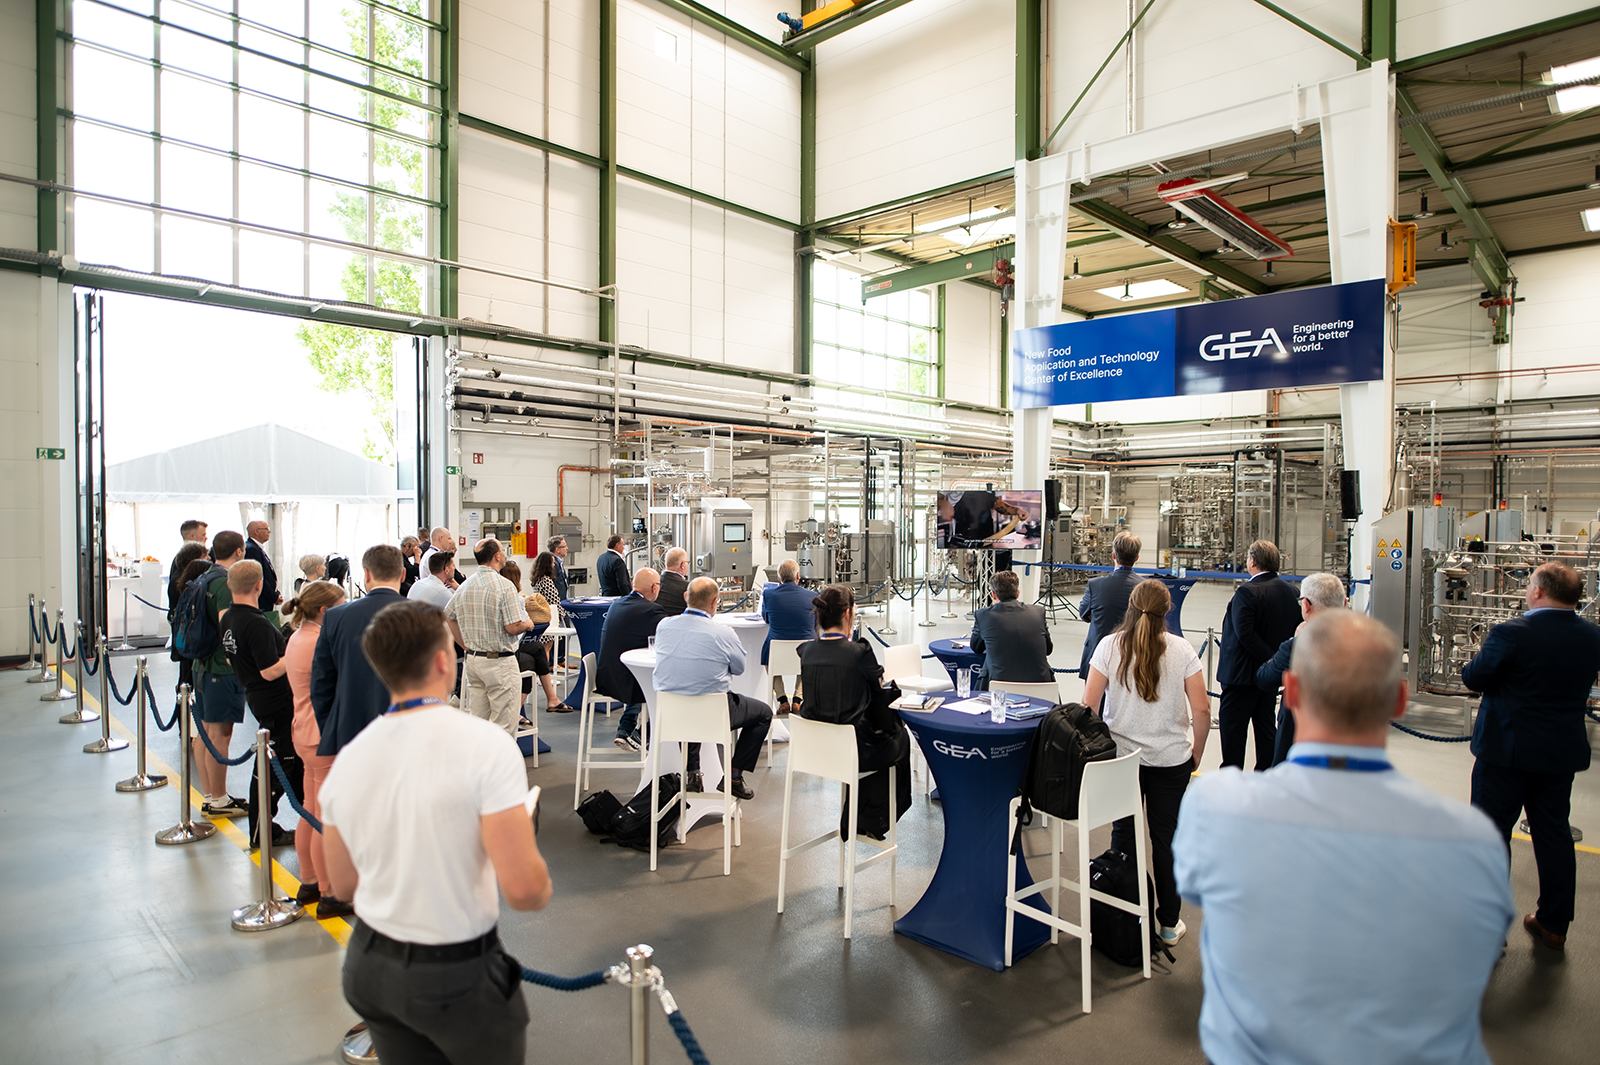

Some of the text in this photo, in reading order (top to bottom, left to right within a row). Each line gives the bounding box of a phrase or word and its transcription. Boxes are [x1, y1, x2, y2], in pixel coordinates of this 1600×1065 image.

[1293, 319, 1354, 334] Engineering
[1199, 327, 1288, 362] GEA
[1293, 330, 1350, 344] for a better
[1024, 346, 1072, 360] New Food
[1293, 342, 1324, 353] world.
[1024, 350, 1160, 375] Application and Technology
[1024, 368, 1123, 385] Center of Excellence
[932, 739, 988, 760] GEA
